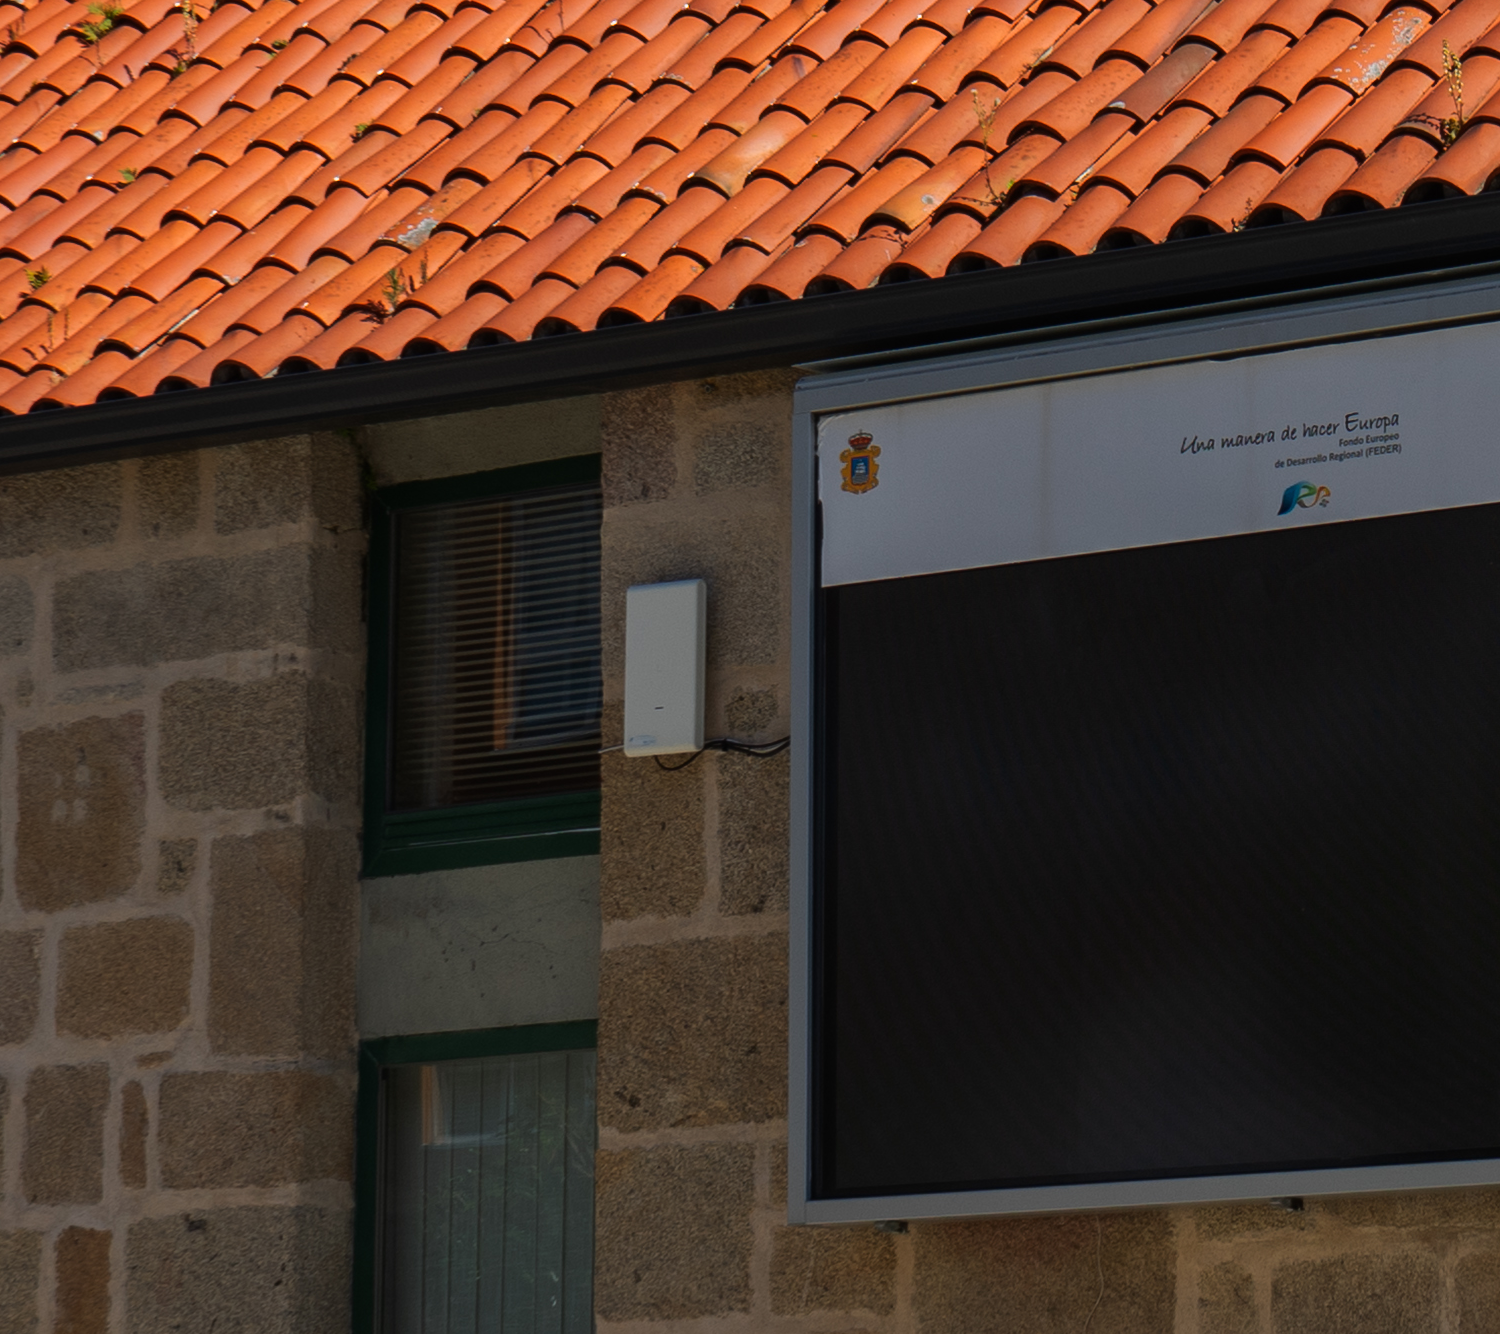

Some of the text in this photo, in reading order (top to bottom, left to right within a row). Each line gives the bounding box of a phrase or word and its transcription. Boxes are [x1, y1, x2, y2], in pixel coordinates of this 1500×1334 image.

[1180, 412, 1400, 454] Una manera de hacer Europa
[1339, 432, 1400, 448] Fondo Europeo
[1274, 443, 1402, 469] de Desarrollo Regional (FEDER)
